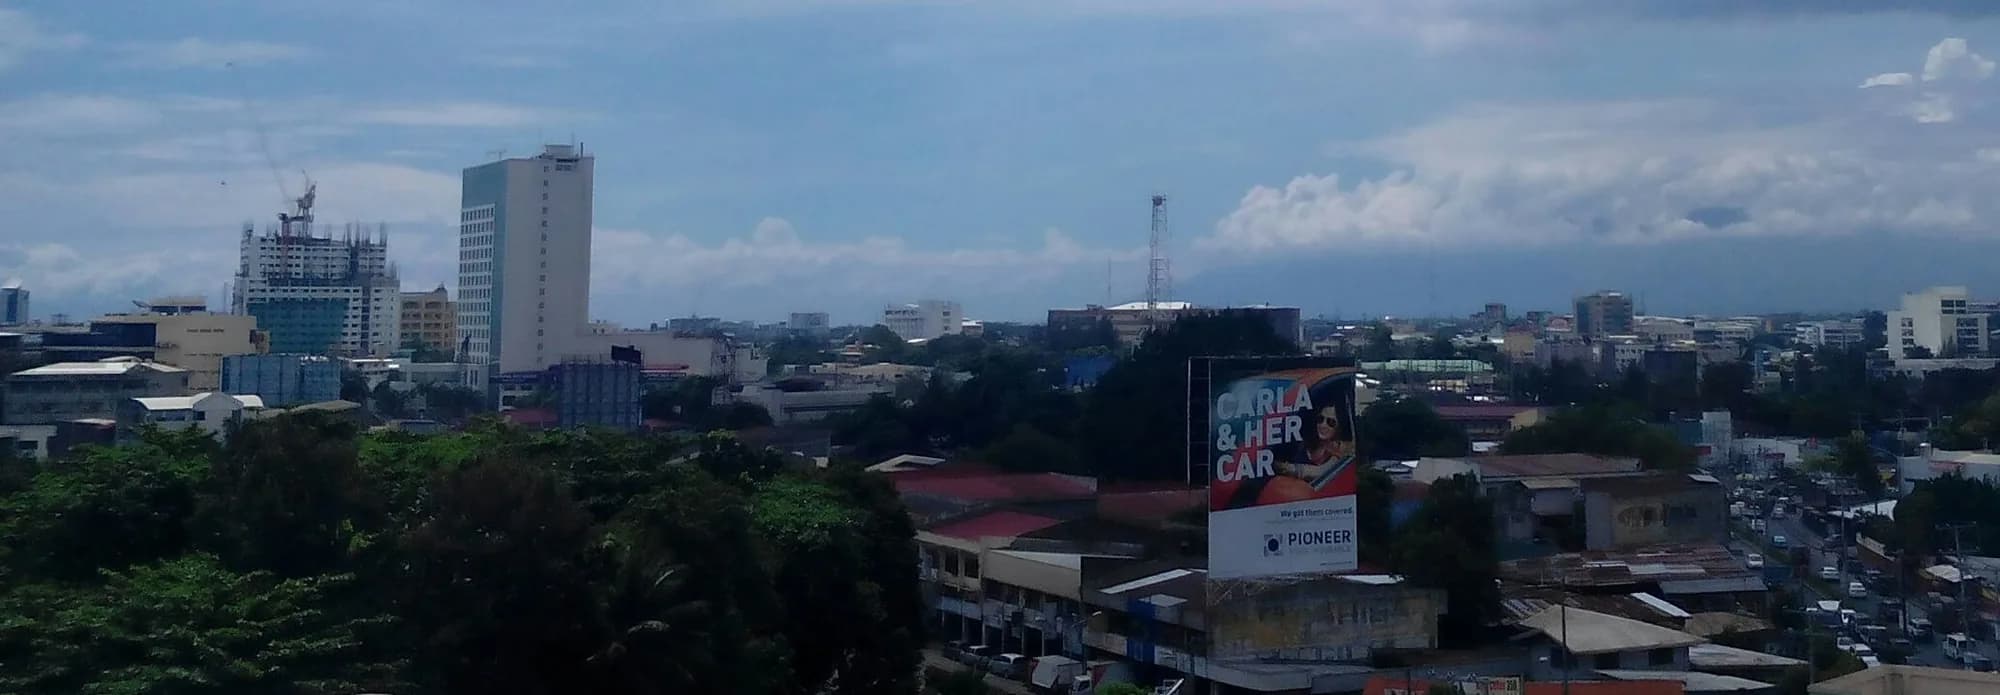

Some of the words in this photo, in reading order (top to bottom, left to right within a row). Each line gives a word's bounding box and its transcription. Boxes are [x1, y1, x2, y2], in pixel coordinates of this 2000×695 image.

[1216, 383, 1313, 420] CARLA
[1216, 423, 1238, 452] &
[1244, 415, 1304, 449] HER
[1216, 448, 1276, 483] CAR
[1288, 530, 1351, 546] PIONEER
